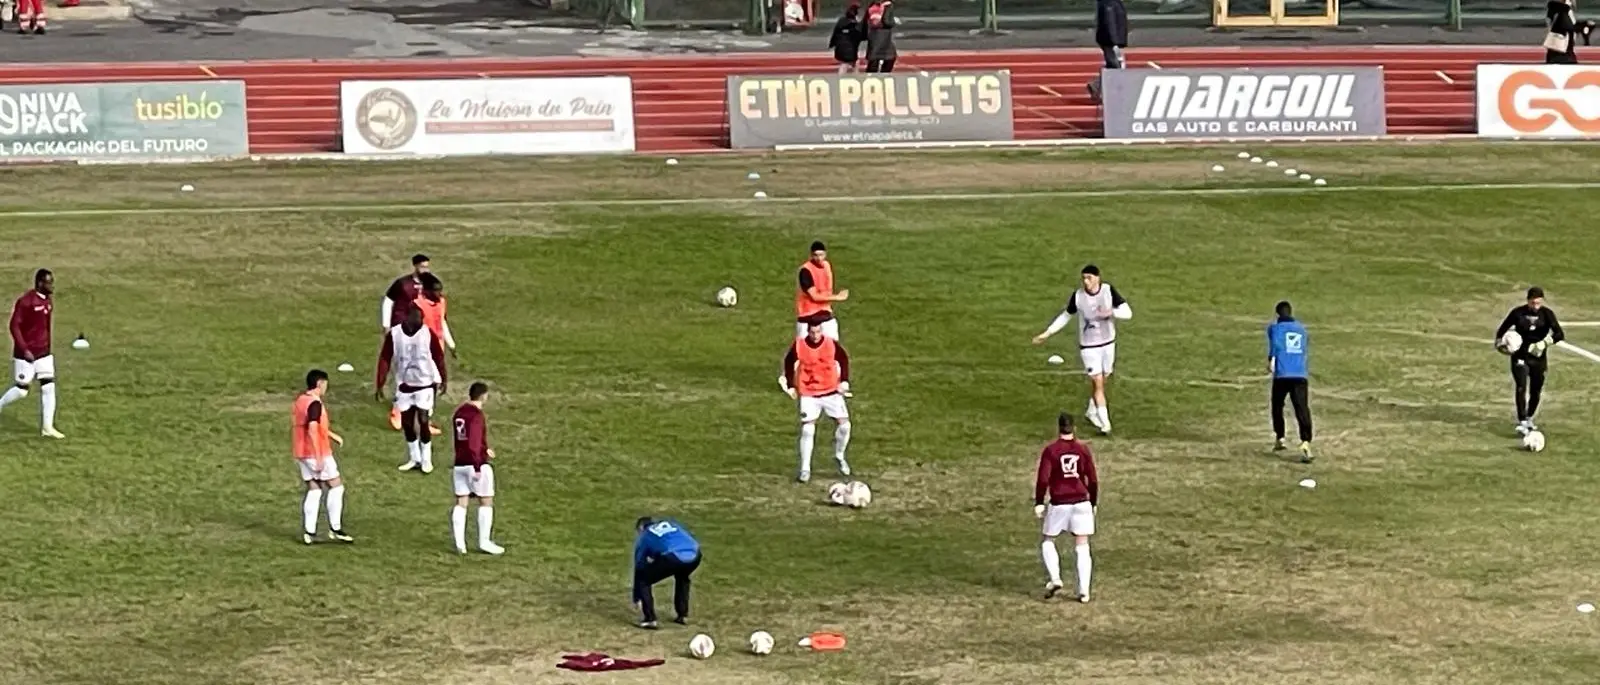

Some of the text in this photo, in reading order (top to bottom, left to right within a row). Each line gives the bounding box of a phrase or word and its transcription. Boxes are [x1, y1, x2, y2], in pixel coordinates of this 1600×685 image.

[20, 92, 82, 113] NIVA
[426, 97, 614, 118] La Maison du Pain
[739, 75, 1002, 119] ETNA PALLETS
[21, 112, 88, 135] PACK
[1132, 120, 1357, 133] GAS AUTO E CARBURANTI
[13, 141, 106, 156] PACKAGING
[108, 140, 140, 153] DEL
[143, 138, 208, 153] FUTURO
